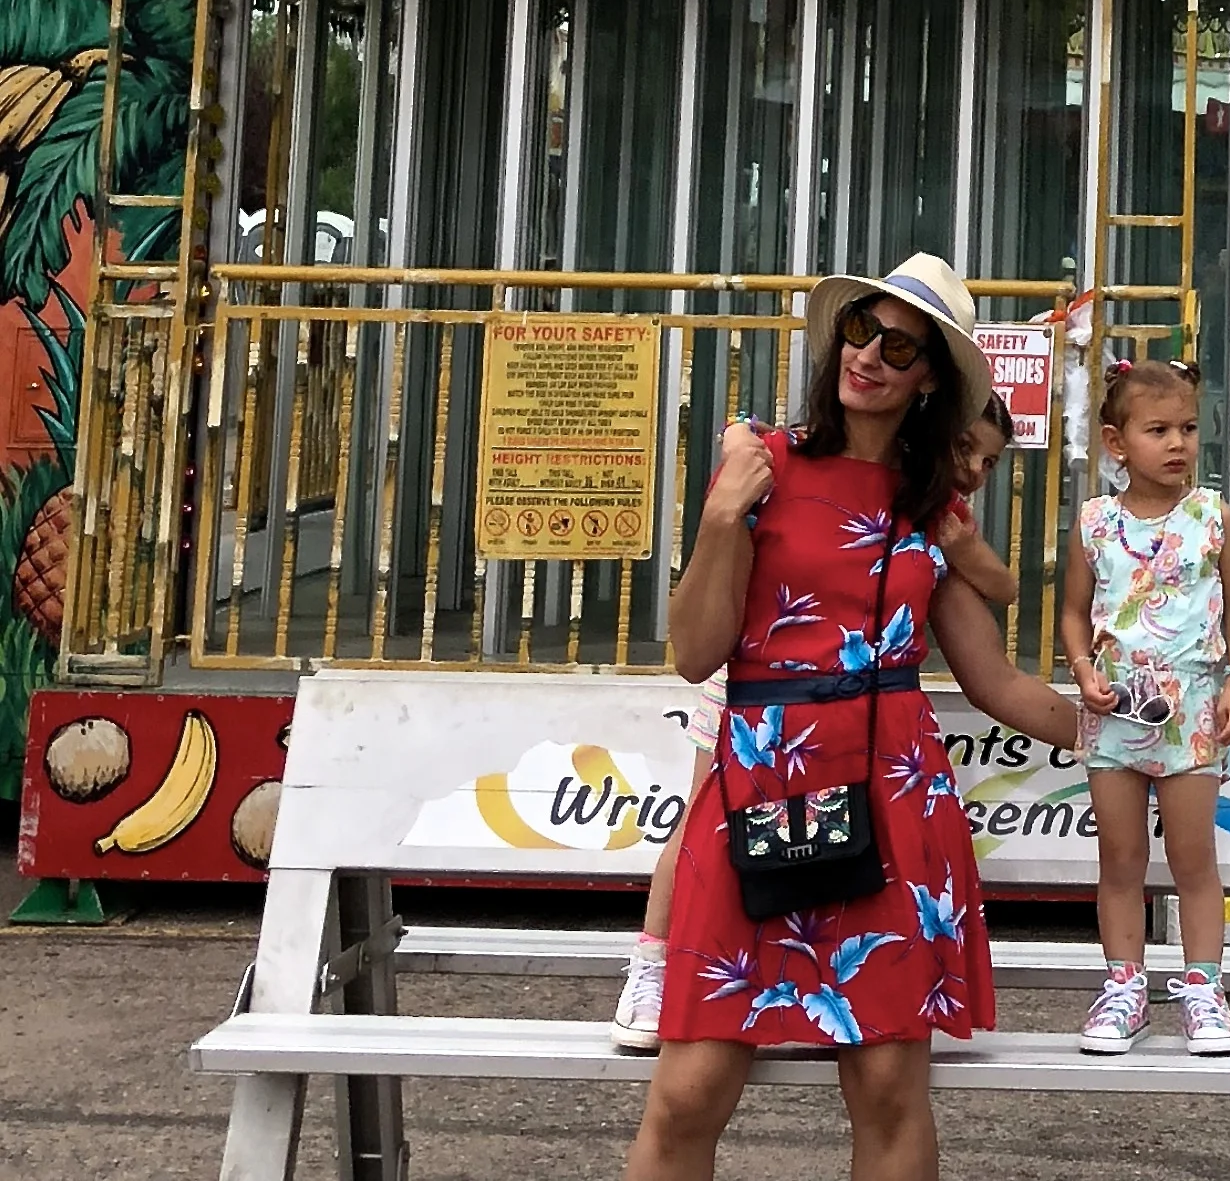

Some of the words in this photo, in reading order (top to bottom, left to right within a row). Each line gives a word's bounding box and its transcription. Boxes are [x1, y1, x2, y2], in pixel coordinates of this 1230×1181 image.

[493, 326, 527, 341] FOR
[532, 326, 577, 341] YOUR
[977, 334, 1028, 351] SAFETY
[994, 356, 1045, 384] SHOES
[1014, 420, 1035, 437] ON
[492, 453, 542, 465] HEIGHT
[553, 497, 568, 506] THE
[943, 725, 1032, 767] nts
[550, 775, 687, 843] Wrig
[965, 800, 1098, 838] seme
